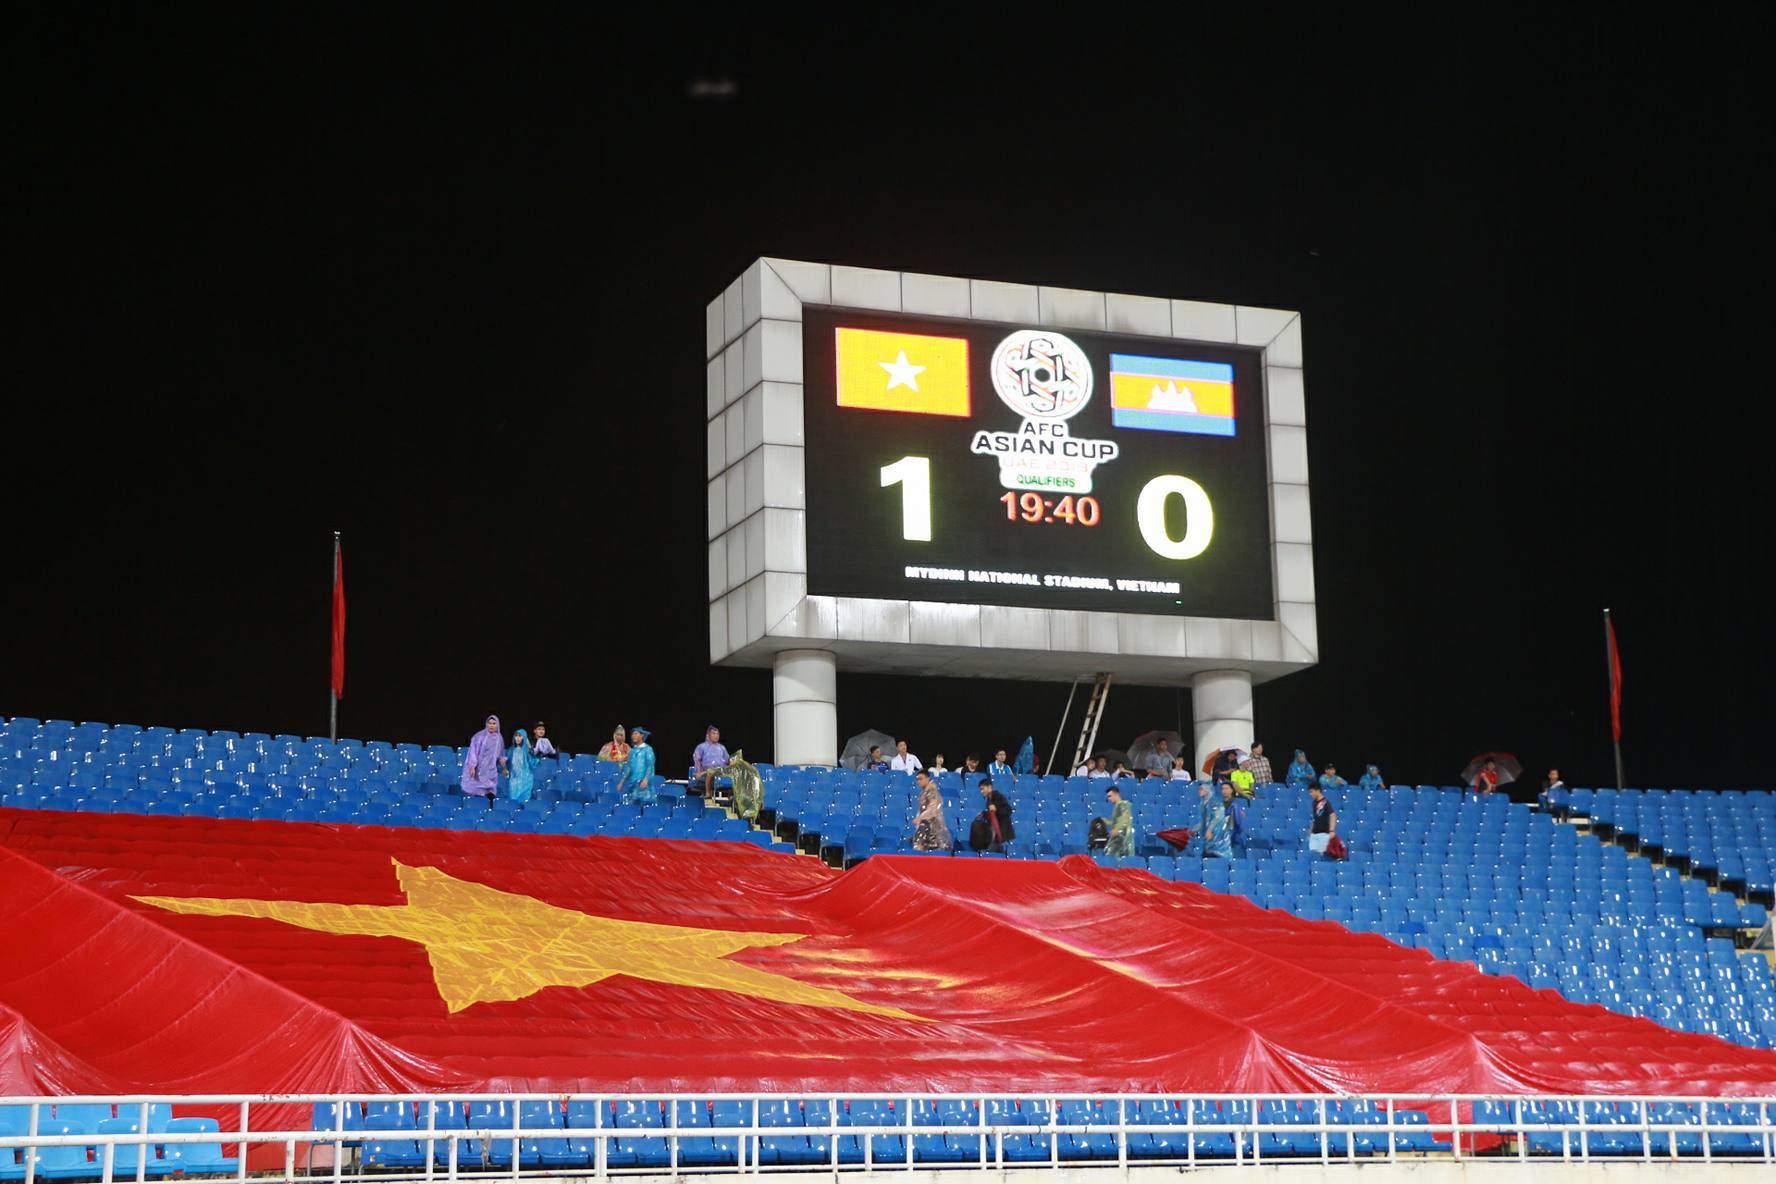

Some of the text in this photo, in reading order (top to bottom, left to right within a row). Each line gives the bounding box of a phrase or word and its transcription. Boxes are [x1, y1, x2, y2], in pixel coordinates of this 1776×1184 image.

[1023, 421, 1064, 437] AFC
[976, 434, 1114, 460] ASIAN CUP
[1016, 473, 1076, 489] QUALIFIERS
[880, 456, 931, 541] 1
[1000, 491, 1100, 527] 19:40
[1137, 474, 1214, 560] 0
[968, 570, 1041, 586] NATIONAL
[1116, 579, 1181, 594] VIETNAM
